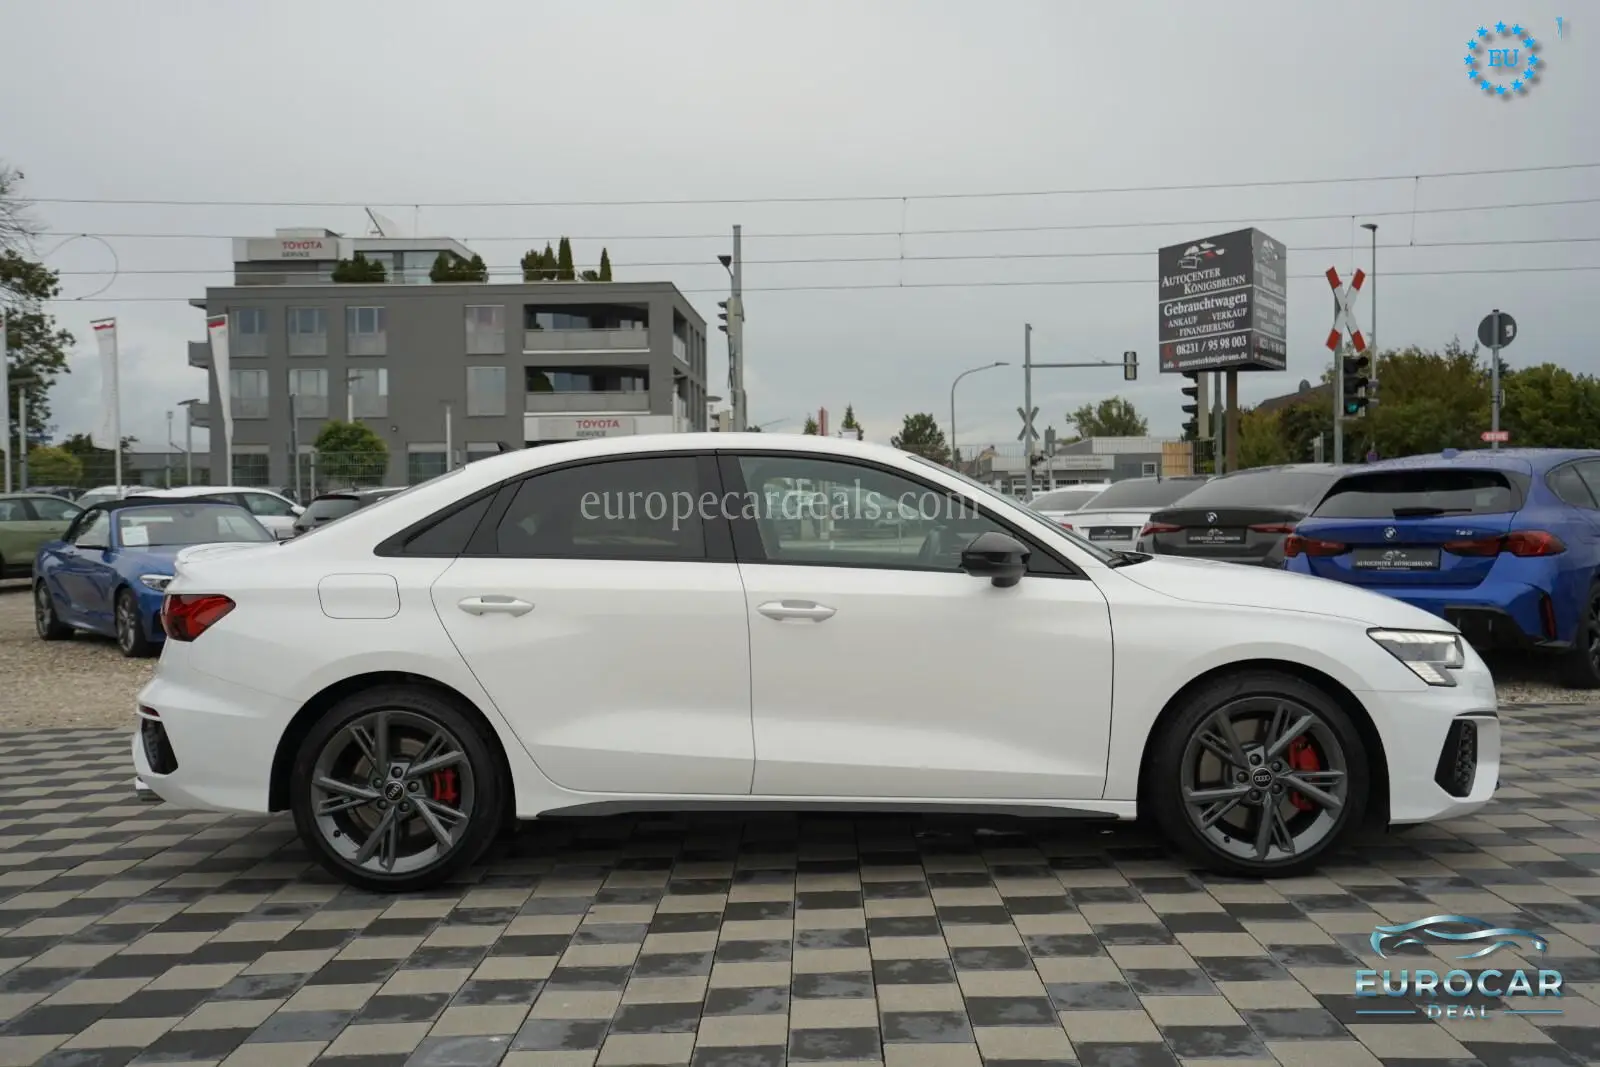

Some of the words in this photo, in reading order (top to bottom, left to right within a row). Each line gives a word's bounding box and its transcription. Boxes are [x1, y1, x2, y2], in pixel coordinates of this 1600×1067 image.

[282, 241, 322, 250] TOYOTA
[1161, 268, 1221, 288] AUTOCENTER
[1164, 293, 1248, 317] Gebrauchtwagen
[1168, 316, 1198, 328] ANKAUF
[1212, 308, 1248, 321] VERKAUF
[1179, 321, 1235, 336] FINANZIERUNG
[1176, 343, 1199, 356] 08231
[1208, 340, 1218, 351] 95
[1232, 335, 1247, 348] 003
[576, 420, 620, 429] TOYOTA
